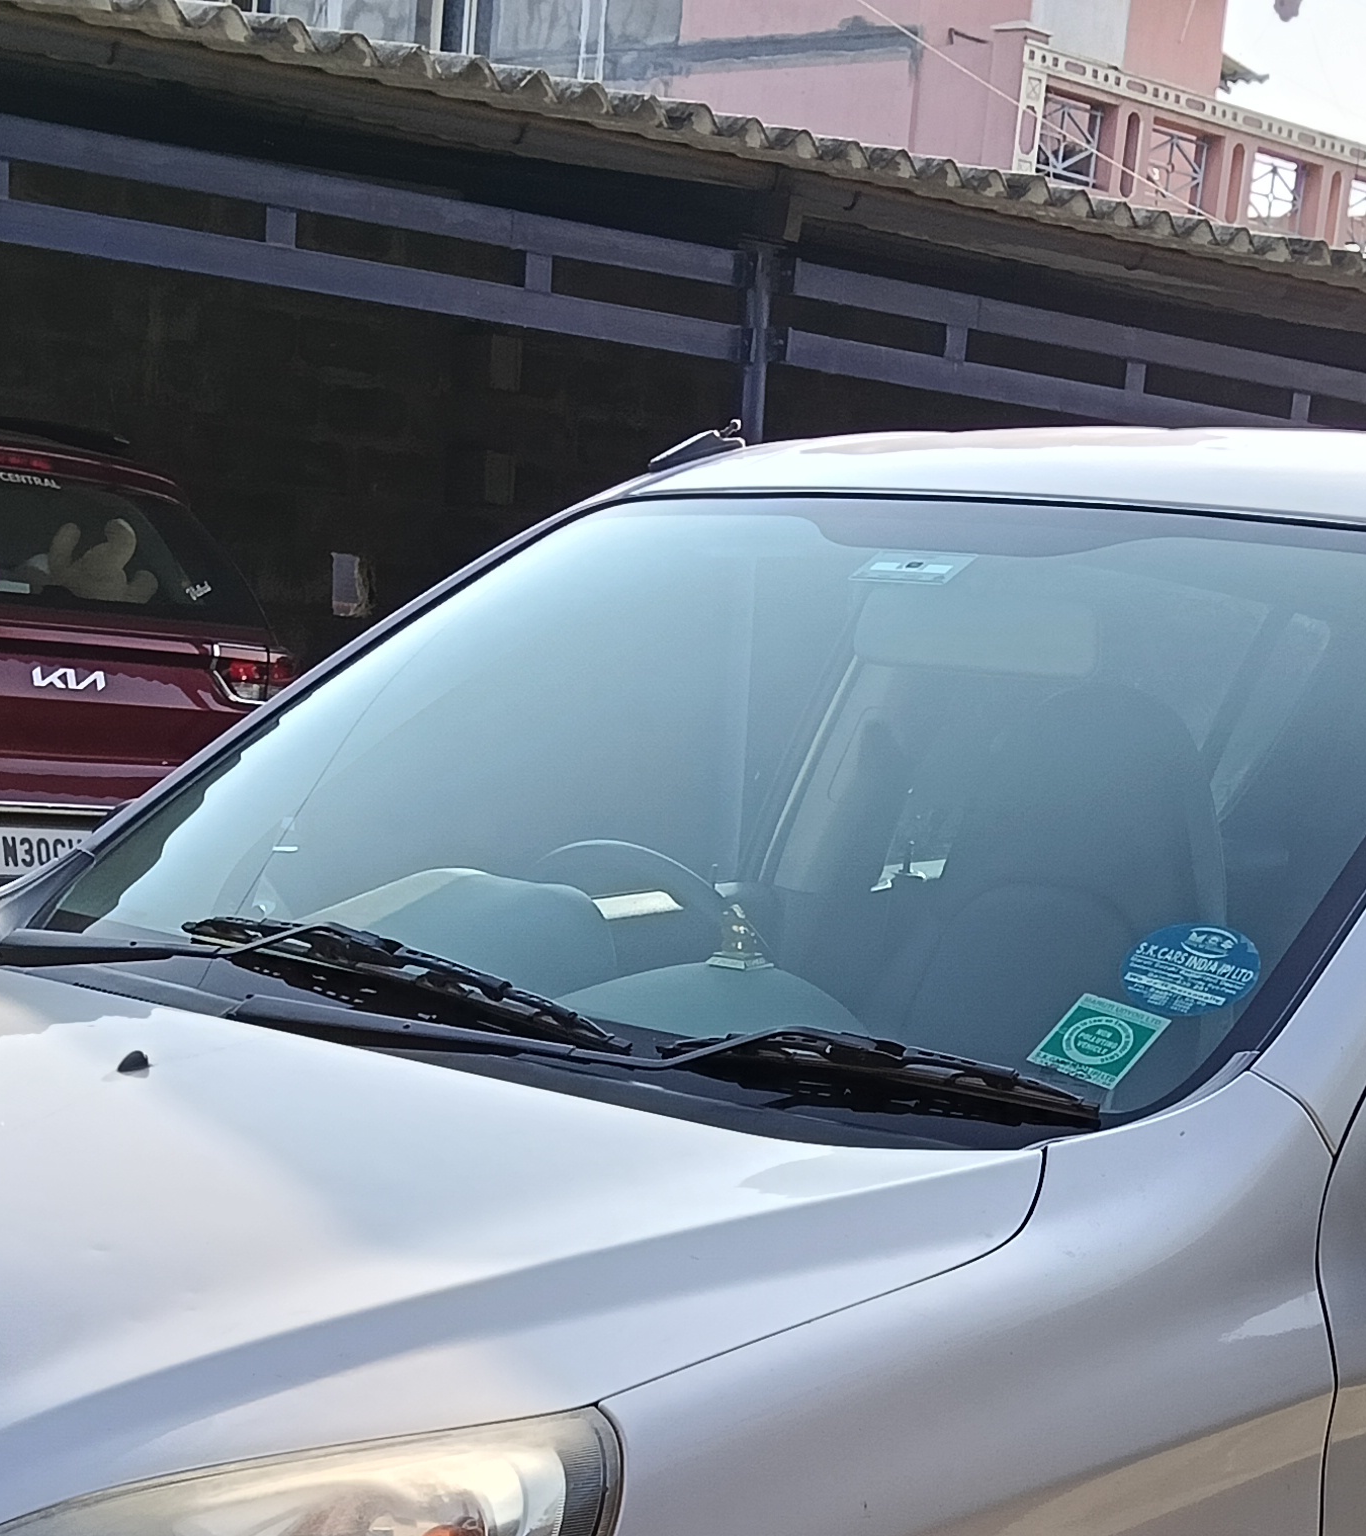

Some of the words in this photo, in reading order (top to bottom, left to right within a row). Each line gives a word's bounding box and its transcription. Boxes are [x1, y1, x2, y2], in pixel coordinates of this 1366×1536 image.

[31, 666, 106, 692] KIA
[1185, 955, 1219, 973] INDIA
[1234, 968, 1255, 983] LTD
